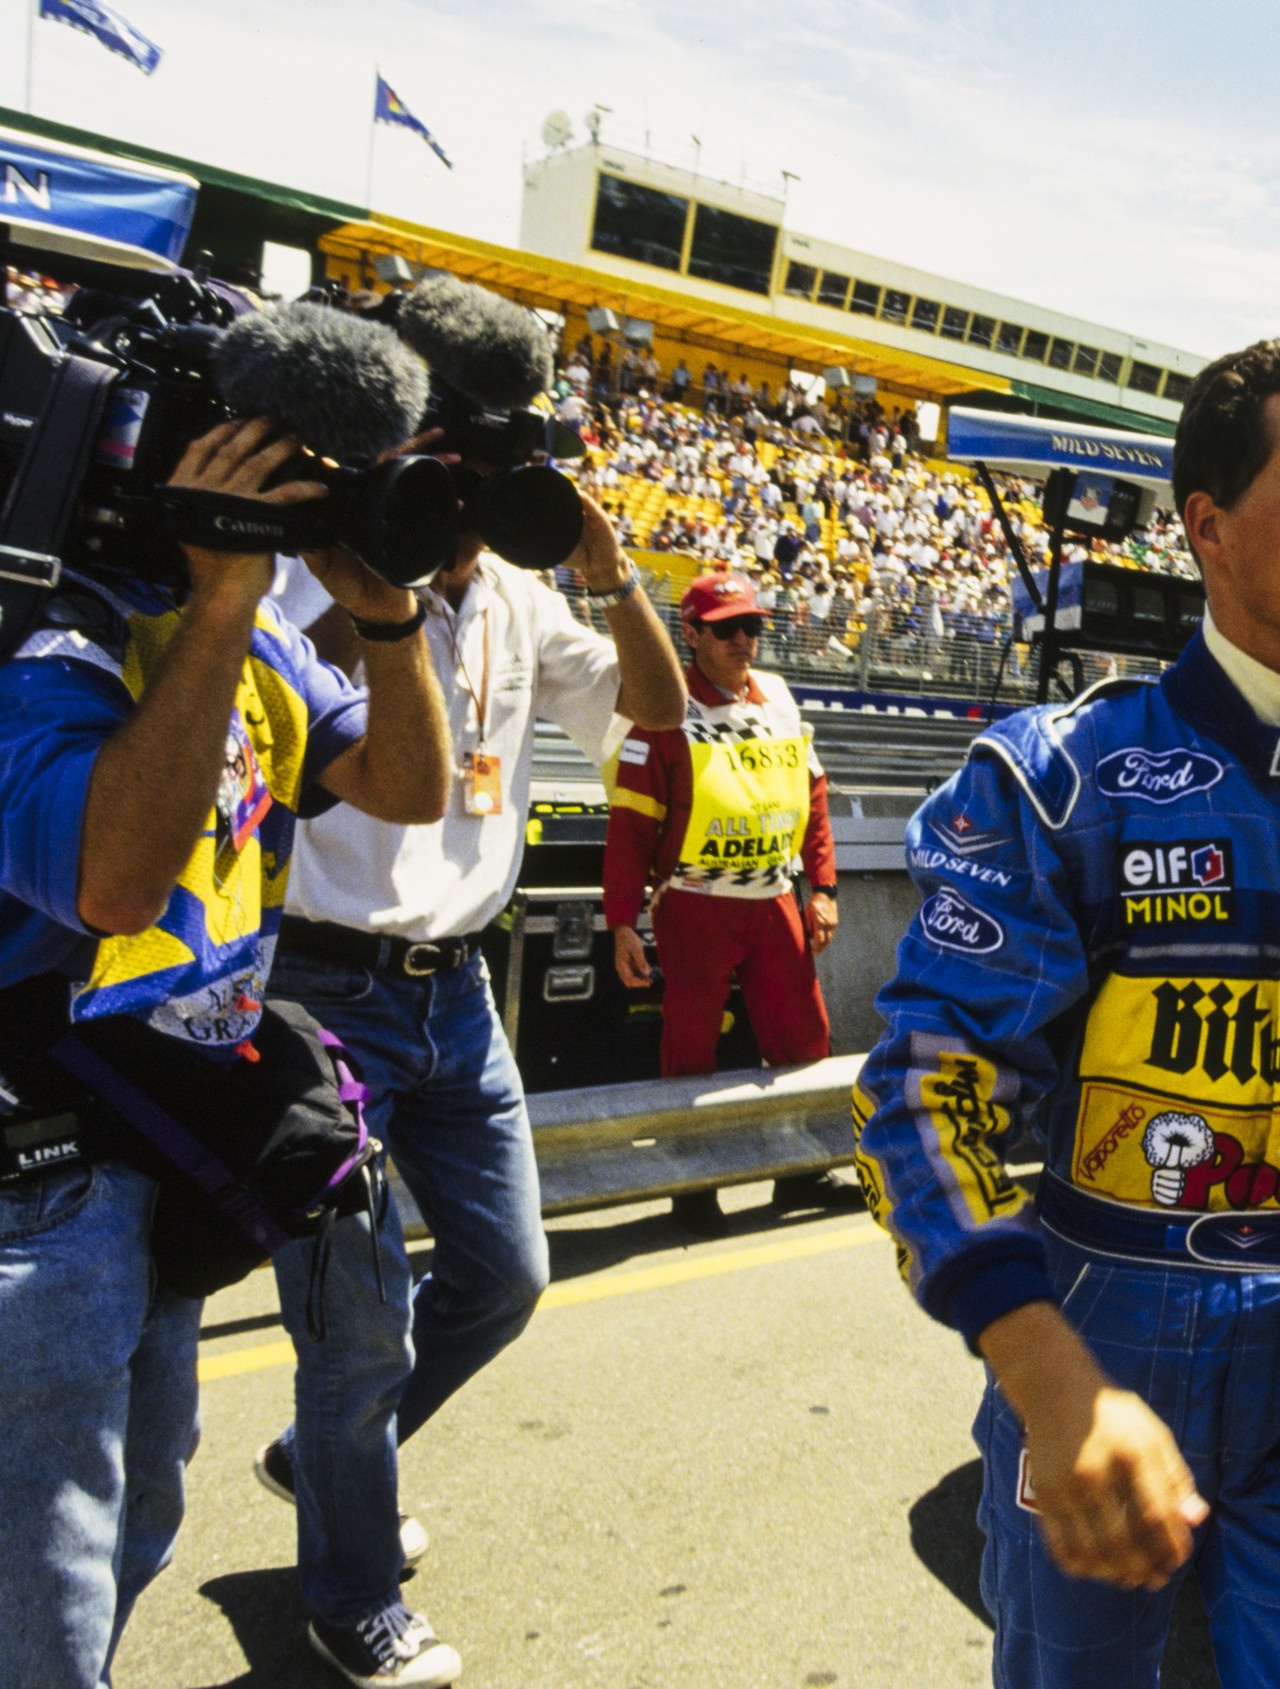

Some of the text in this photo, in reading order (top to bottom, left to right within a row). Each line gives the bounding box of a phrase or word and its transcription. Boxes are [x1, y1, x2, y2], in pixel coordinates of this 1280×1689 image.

[1052, 434, 1163, 468] MILD SEVEN
[214, 516, 284, 536] Canon
[1118, 753, 1195, 791] Ford
[705, 816, 751, 837] ALL
[910, 849, 1012, 887] MILD SEVEN
[1123, 846, 1188, 886] elf
[928, 892, 979, 944] Ford
[1126, 893, 1229, 924] MINOL
[19, 1142, 78, 1166] LINK
[1079, 1103, 1146, 1182] Vaporetto
